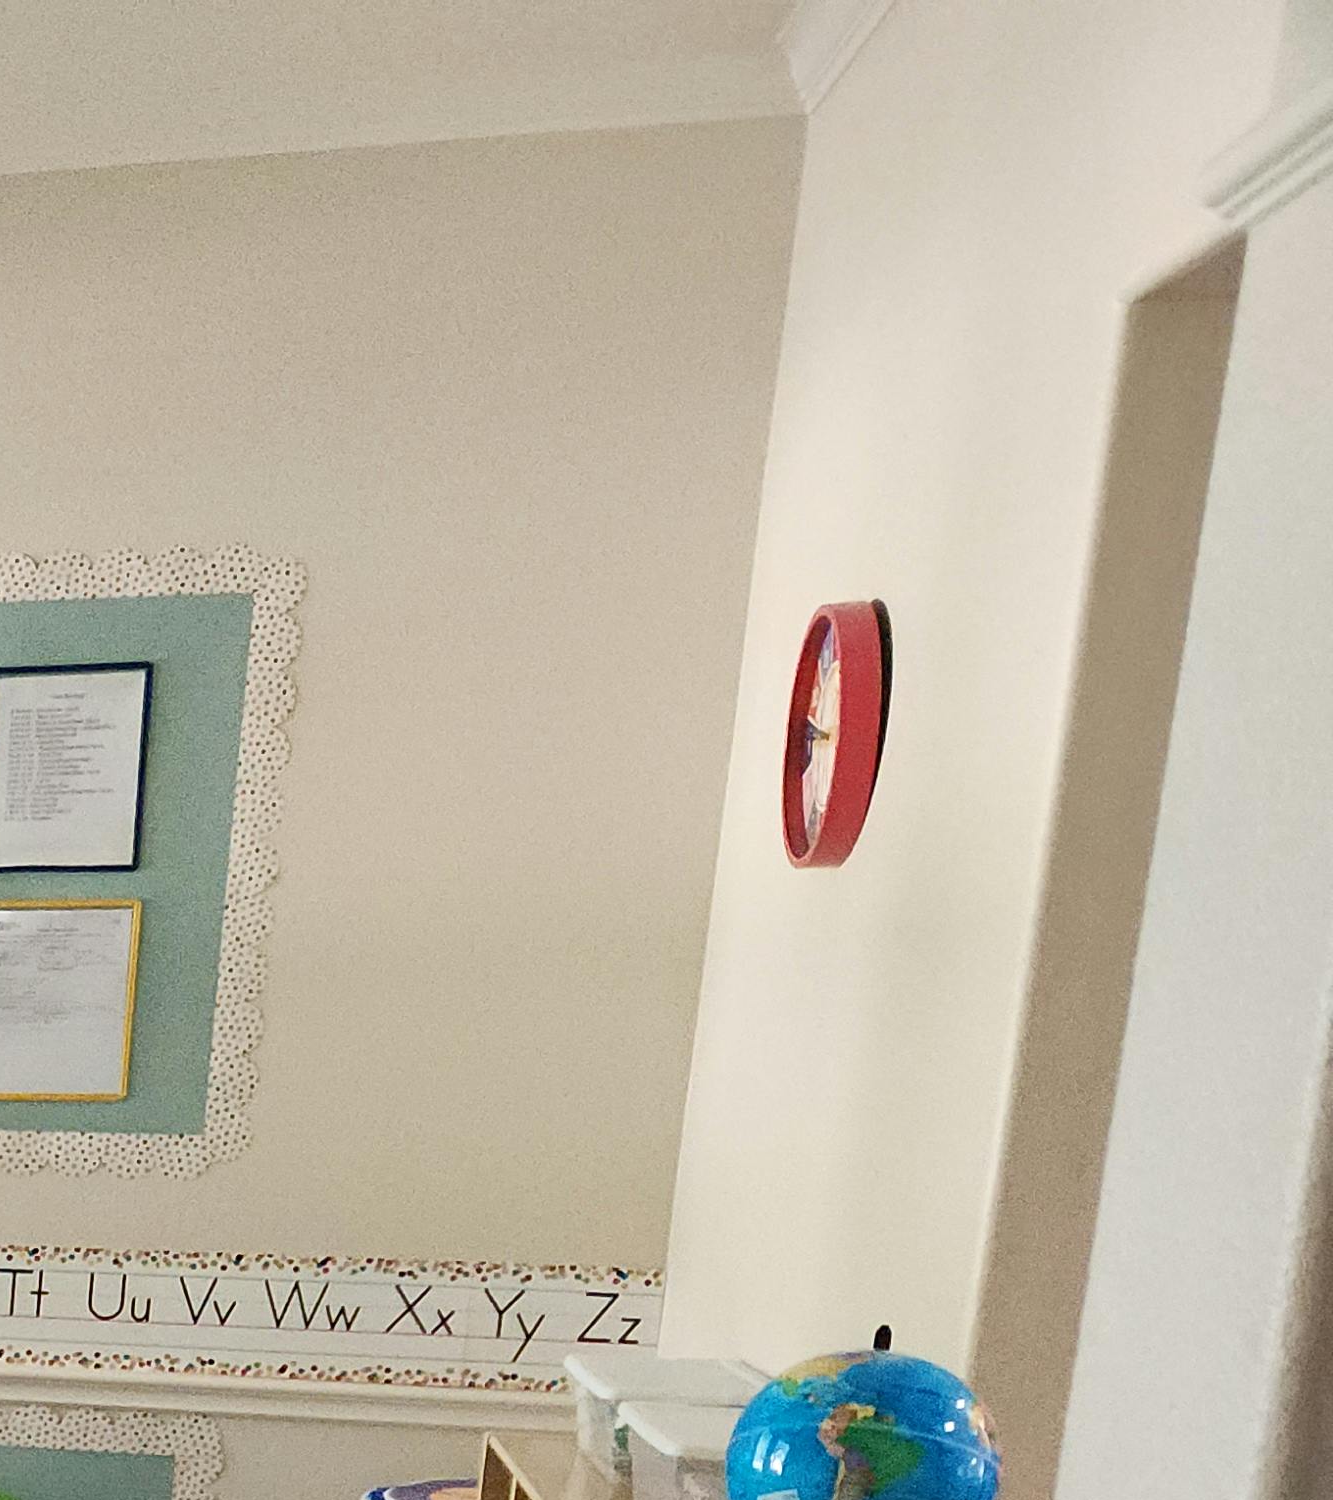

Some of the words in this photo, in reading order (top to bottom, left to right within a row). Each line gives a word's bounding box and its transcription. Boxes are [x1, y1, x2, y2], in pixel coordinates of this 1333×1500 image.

[87, 1272, 152, 1323] Uu
[180, 1276, 237, 1327] Vv
[264, 1279, 360, 1332] Ww
[385, 1284, 455, 1336] Xx
[485, 1287, 545, 1363] Yy
[577, 1291, 642, 1345] Zz
